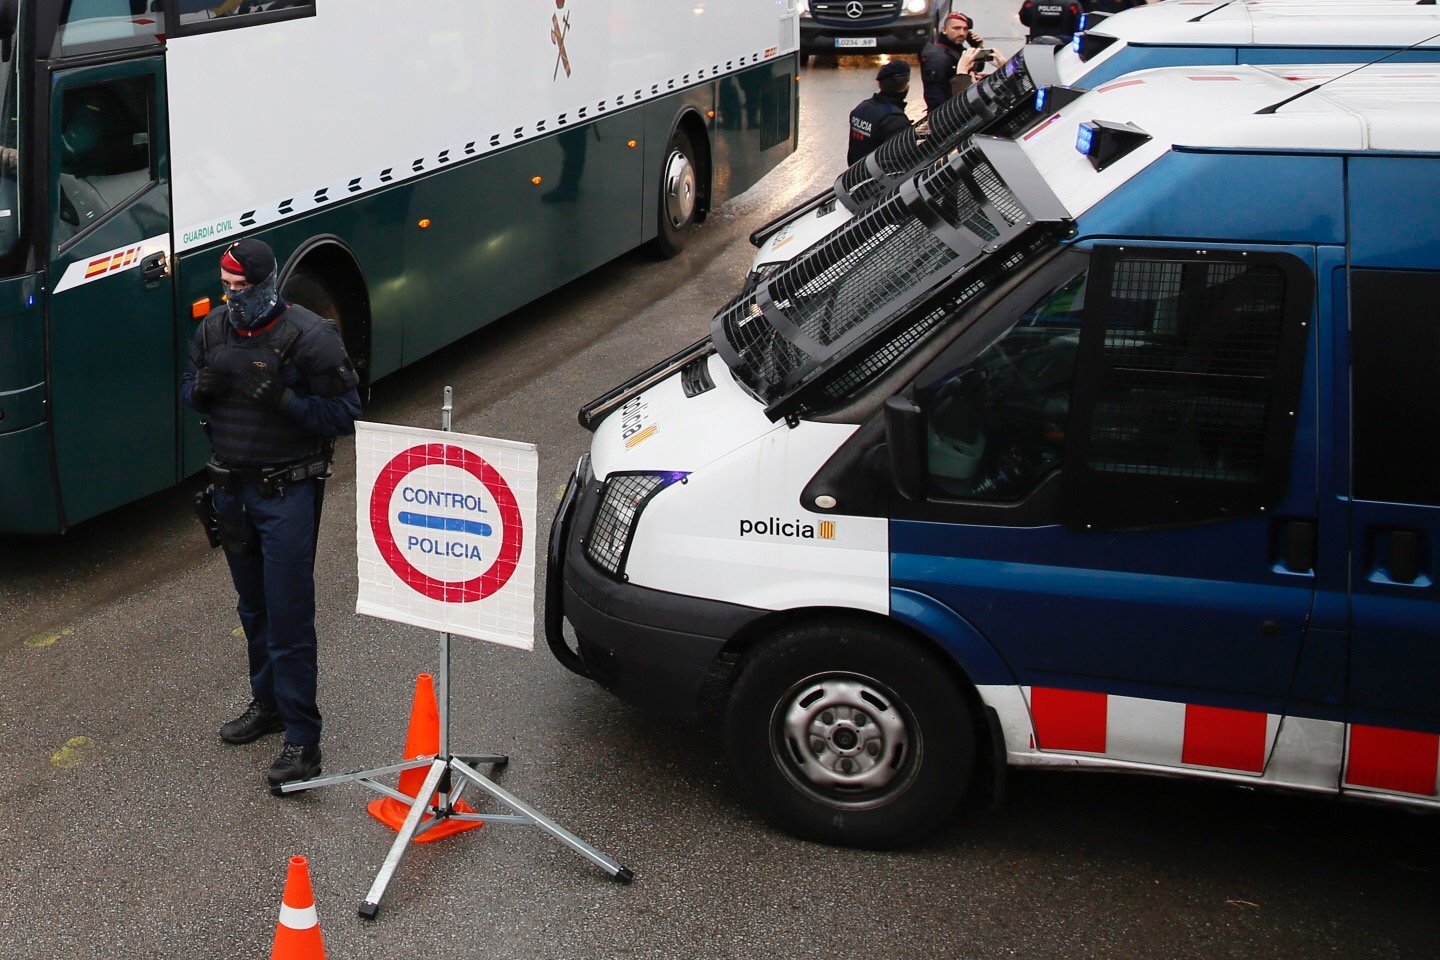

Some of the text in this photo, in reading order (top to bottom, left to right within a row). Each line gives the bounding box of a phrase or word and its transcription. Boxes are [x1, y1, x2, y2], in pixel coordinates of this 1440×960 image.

[851, 116, 872, 133] POLICIA
[183, 220, 233, 244] GUARDIA CIVIL
[402, 485, 488, 514] CONTROL
[740, 517, 815, 539] policia
[407, 535, 482, 561] POLICIA
